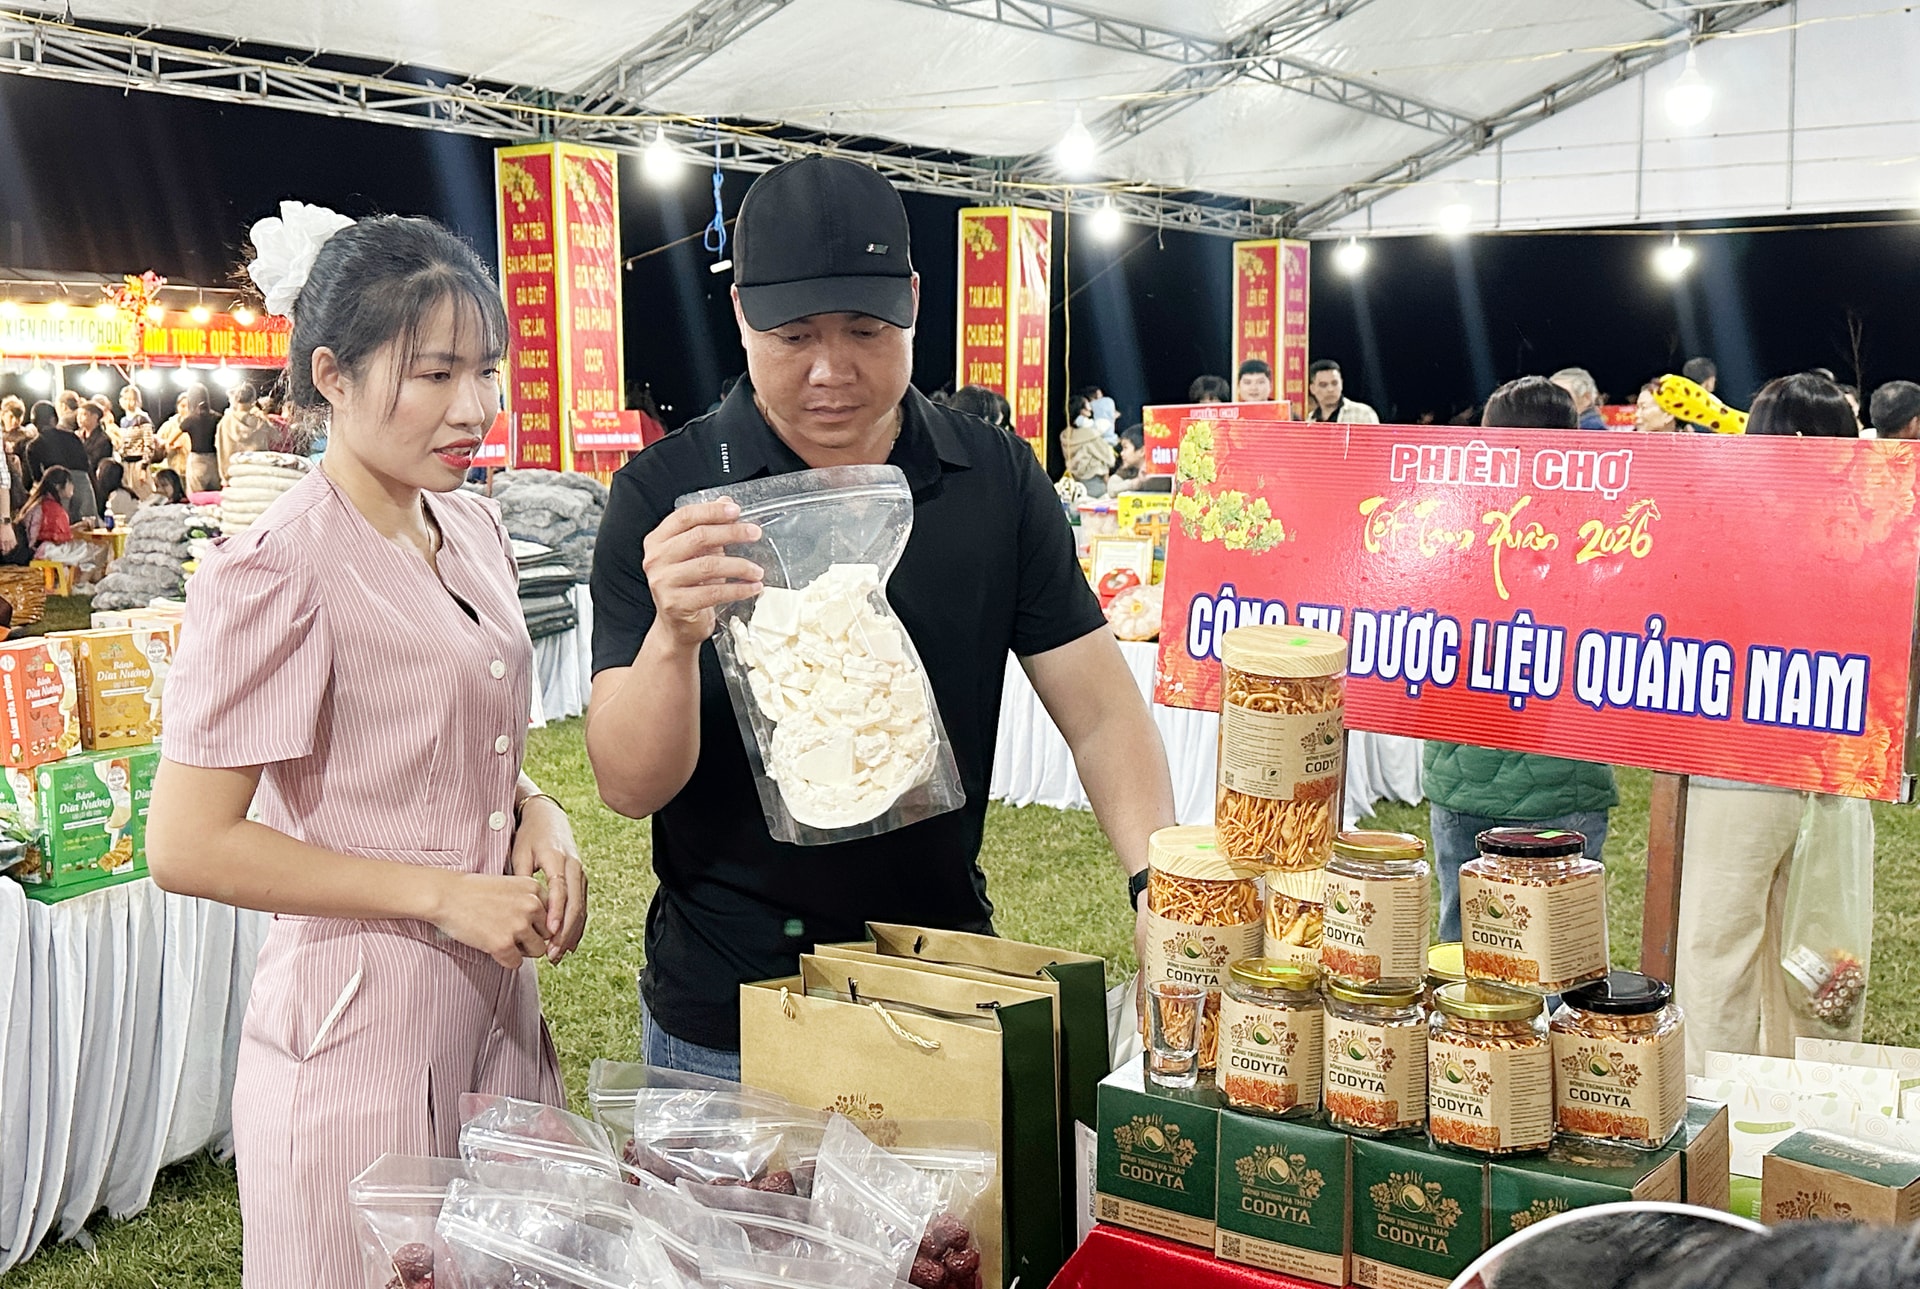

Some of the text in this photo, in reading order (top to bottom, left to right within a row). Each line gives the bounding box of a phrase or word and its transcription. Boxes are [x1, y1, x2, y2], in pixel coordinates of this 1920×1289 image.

[1390, 441, 1634, 500] PHIÊN CHỢ
[1359, 495, 1656, 600] Tết Tam Xuân 2026
[97, 670, 117, 681] Dừa
[113, 661, 134, 670] Bánh
[1346, 608, 1462, 699] DƯỢC
[1467, 608, 1567, 712] LIỆU
[1574, 614, 1736, 720] QUẢNG
[1743, 645, 1871, 736] NAM
[75, 790, 95, 801] Bánh
[59, 802, 79, 814] Dừa
[1472, 931, 1523, 950] CODYTA
[1166, 968, 1219, 985] CODYTA
[1231, 1056, 1288, 1076] CODYTA
[1329, 1071, 1385, 1093] CODYTA
[1430, 1095, 1484, 1117] CODYTA
[1569, 1088, 1631, 1108] CODYTA
[1808, 1142, 1883, 1170] CODYTA
[1120, 1163, 1184, 1190] CODYTA
[1241, 1196, 1311, 1225] CODYTA
[1377, 1223, 1449, 1254] CODYTA
